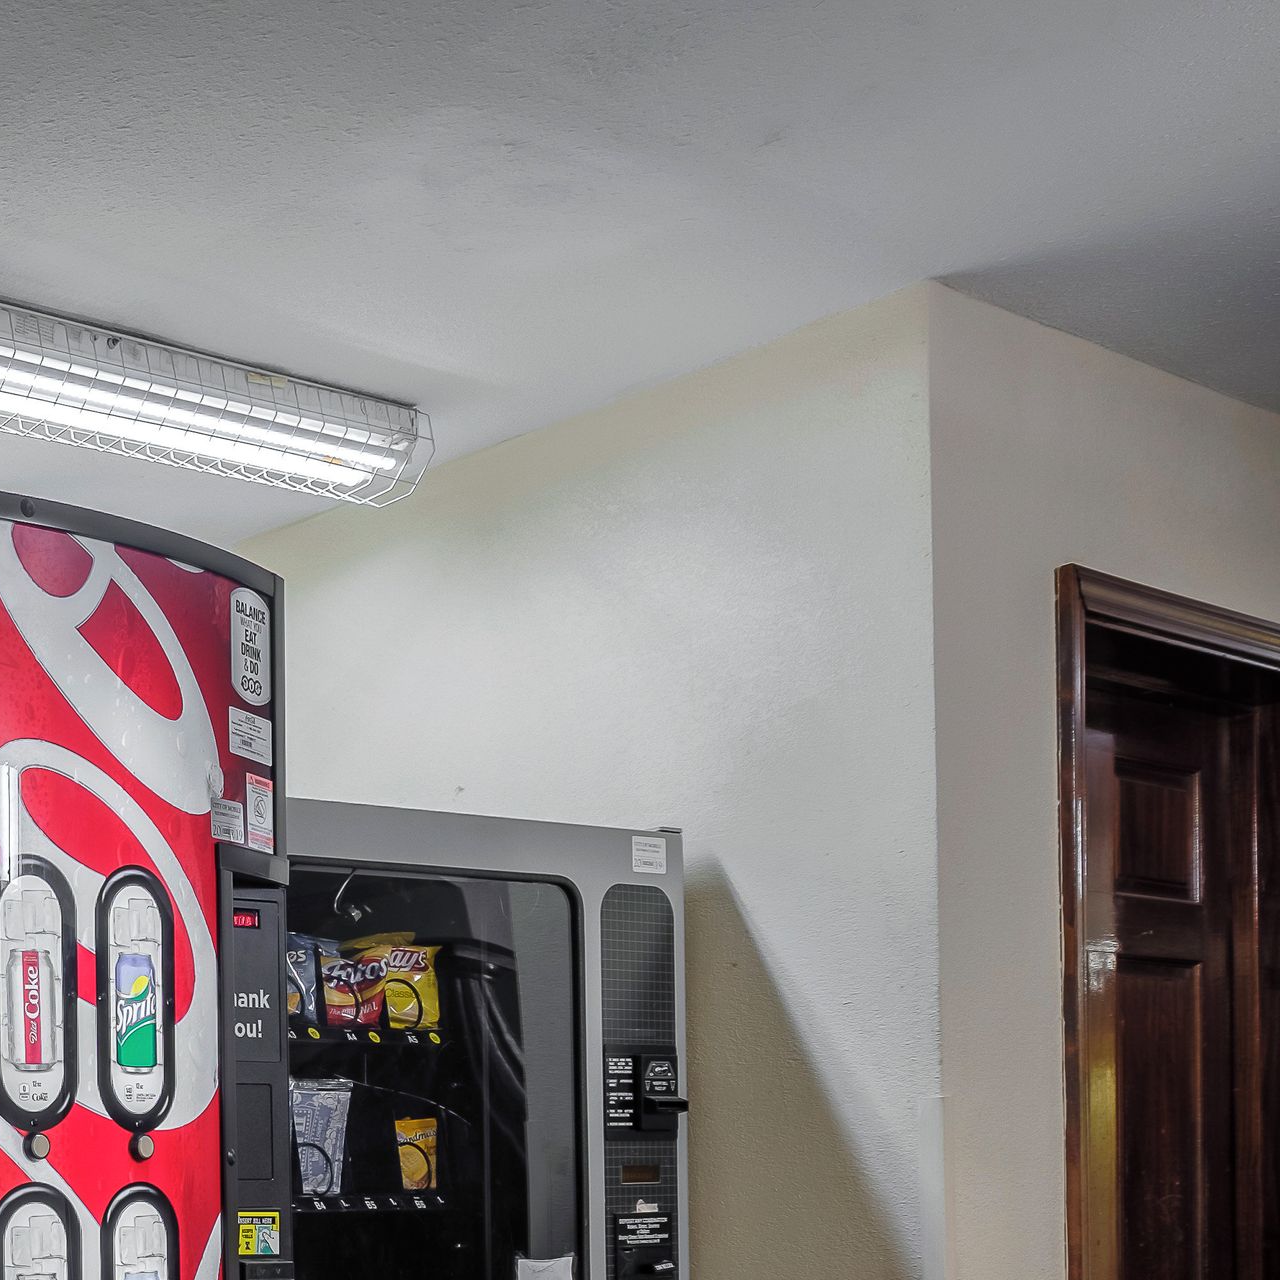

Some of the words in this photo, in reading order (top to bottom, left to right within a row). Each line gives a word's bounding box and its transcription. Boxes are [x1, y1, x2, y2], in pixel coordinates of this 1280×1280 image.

[235, 599, 266, 625] BALANCE
[244, 628, 257, 645] EAT
[241, 641, 261, 662] DRINK
[244, 658, 249, 672] &
[249, 660, 259, 675] DO
[24, 965, 40, 1020] Coke
[116, 969, 156, 1037] Sprite
[233, 988, 271, 1009] ank
[234, 1019, 263, 1038] ou!
